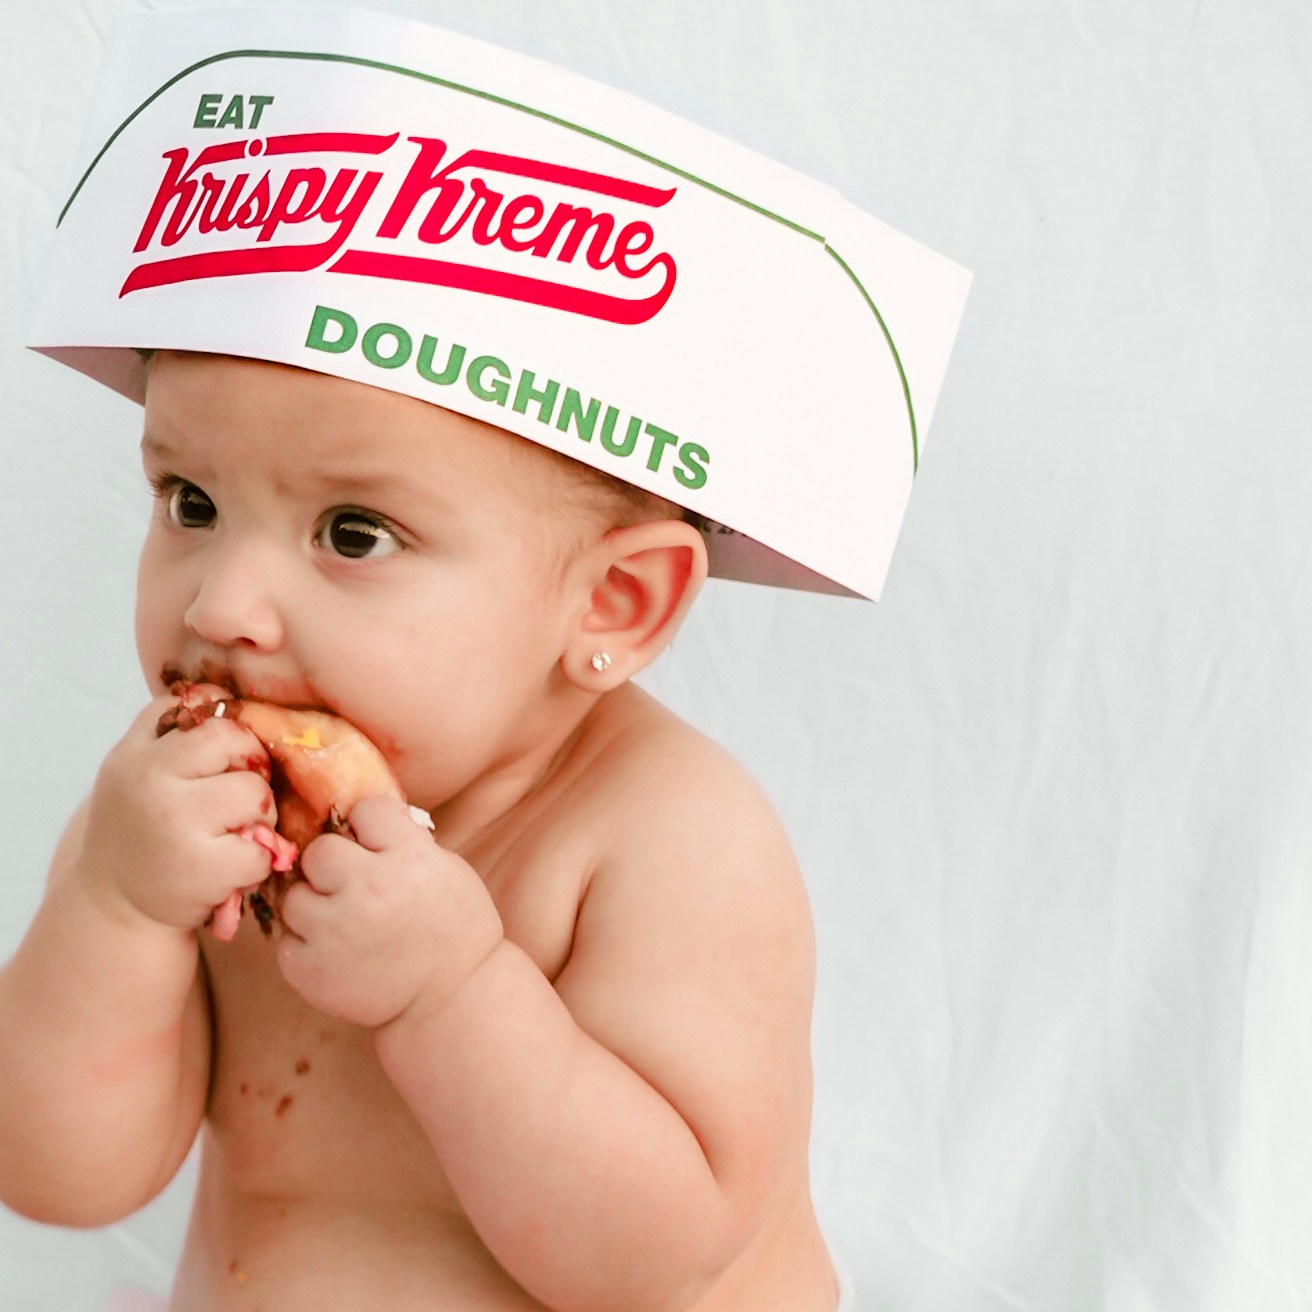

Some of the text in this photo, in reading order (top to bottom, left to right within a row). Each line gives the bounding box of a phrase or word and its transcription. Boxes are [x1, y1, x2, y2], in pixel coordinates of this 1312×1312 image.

[192, 93, 274, 130] EAT
[118, 130, 678, 326] Krispy Kreme
[304, 304, 711, 490] DOUGHNUTS
